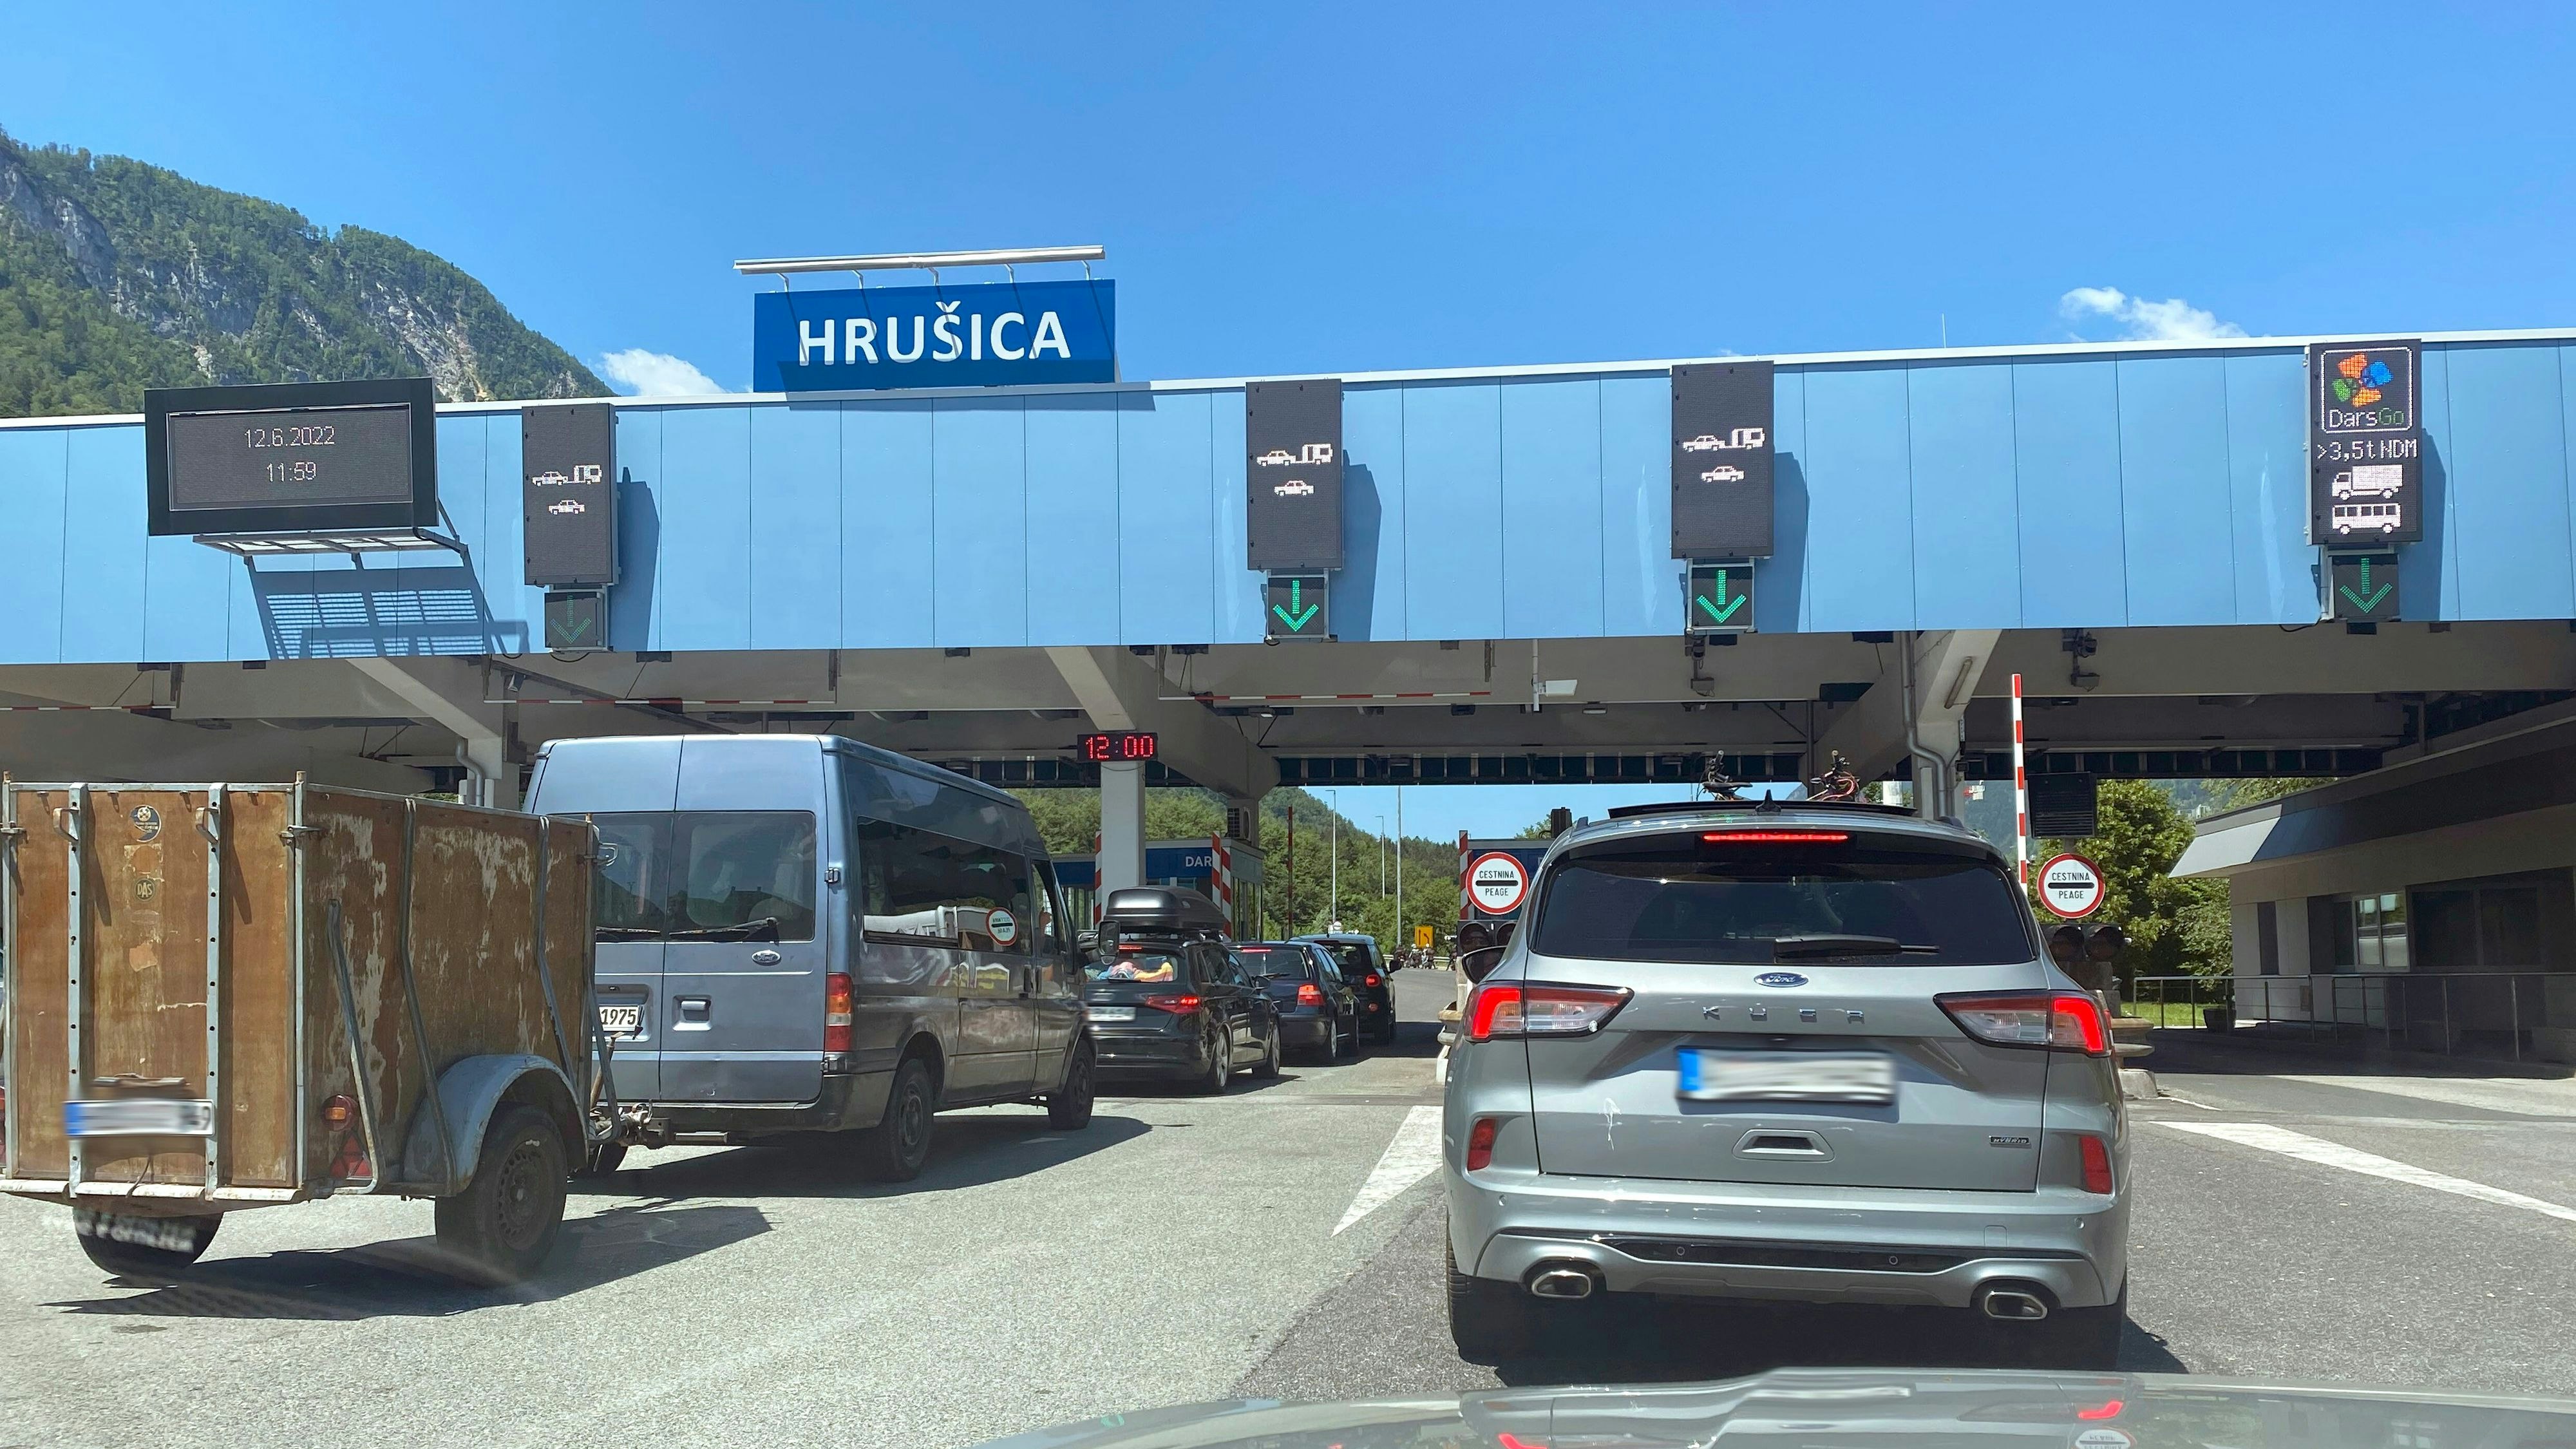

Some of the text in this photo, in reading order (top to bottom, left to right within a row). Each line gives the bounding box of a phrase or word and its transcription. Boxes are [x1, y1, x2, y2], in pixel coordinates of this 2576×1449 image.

[799, 301, 1072, 366] HRUŠICA
[2329, 408, 2405, 428] DarsGo
[244, 426, 335, 448] 12.6.2022
[2381, 439, 2418, 458] NDM
[266, 462, 316, 482] 11:59
[1085, 735, 1153, 759] 12:00
[1479, 870, 1515, 879] CESTNINA
[2052, 872, 2090, 881] CESTNINA
[137, 882, 153, 898] DAS
[2058, 890, 2085, 899] PEAGE
[601, 1009, 637, 1025] 1975
